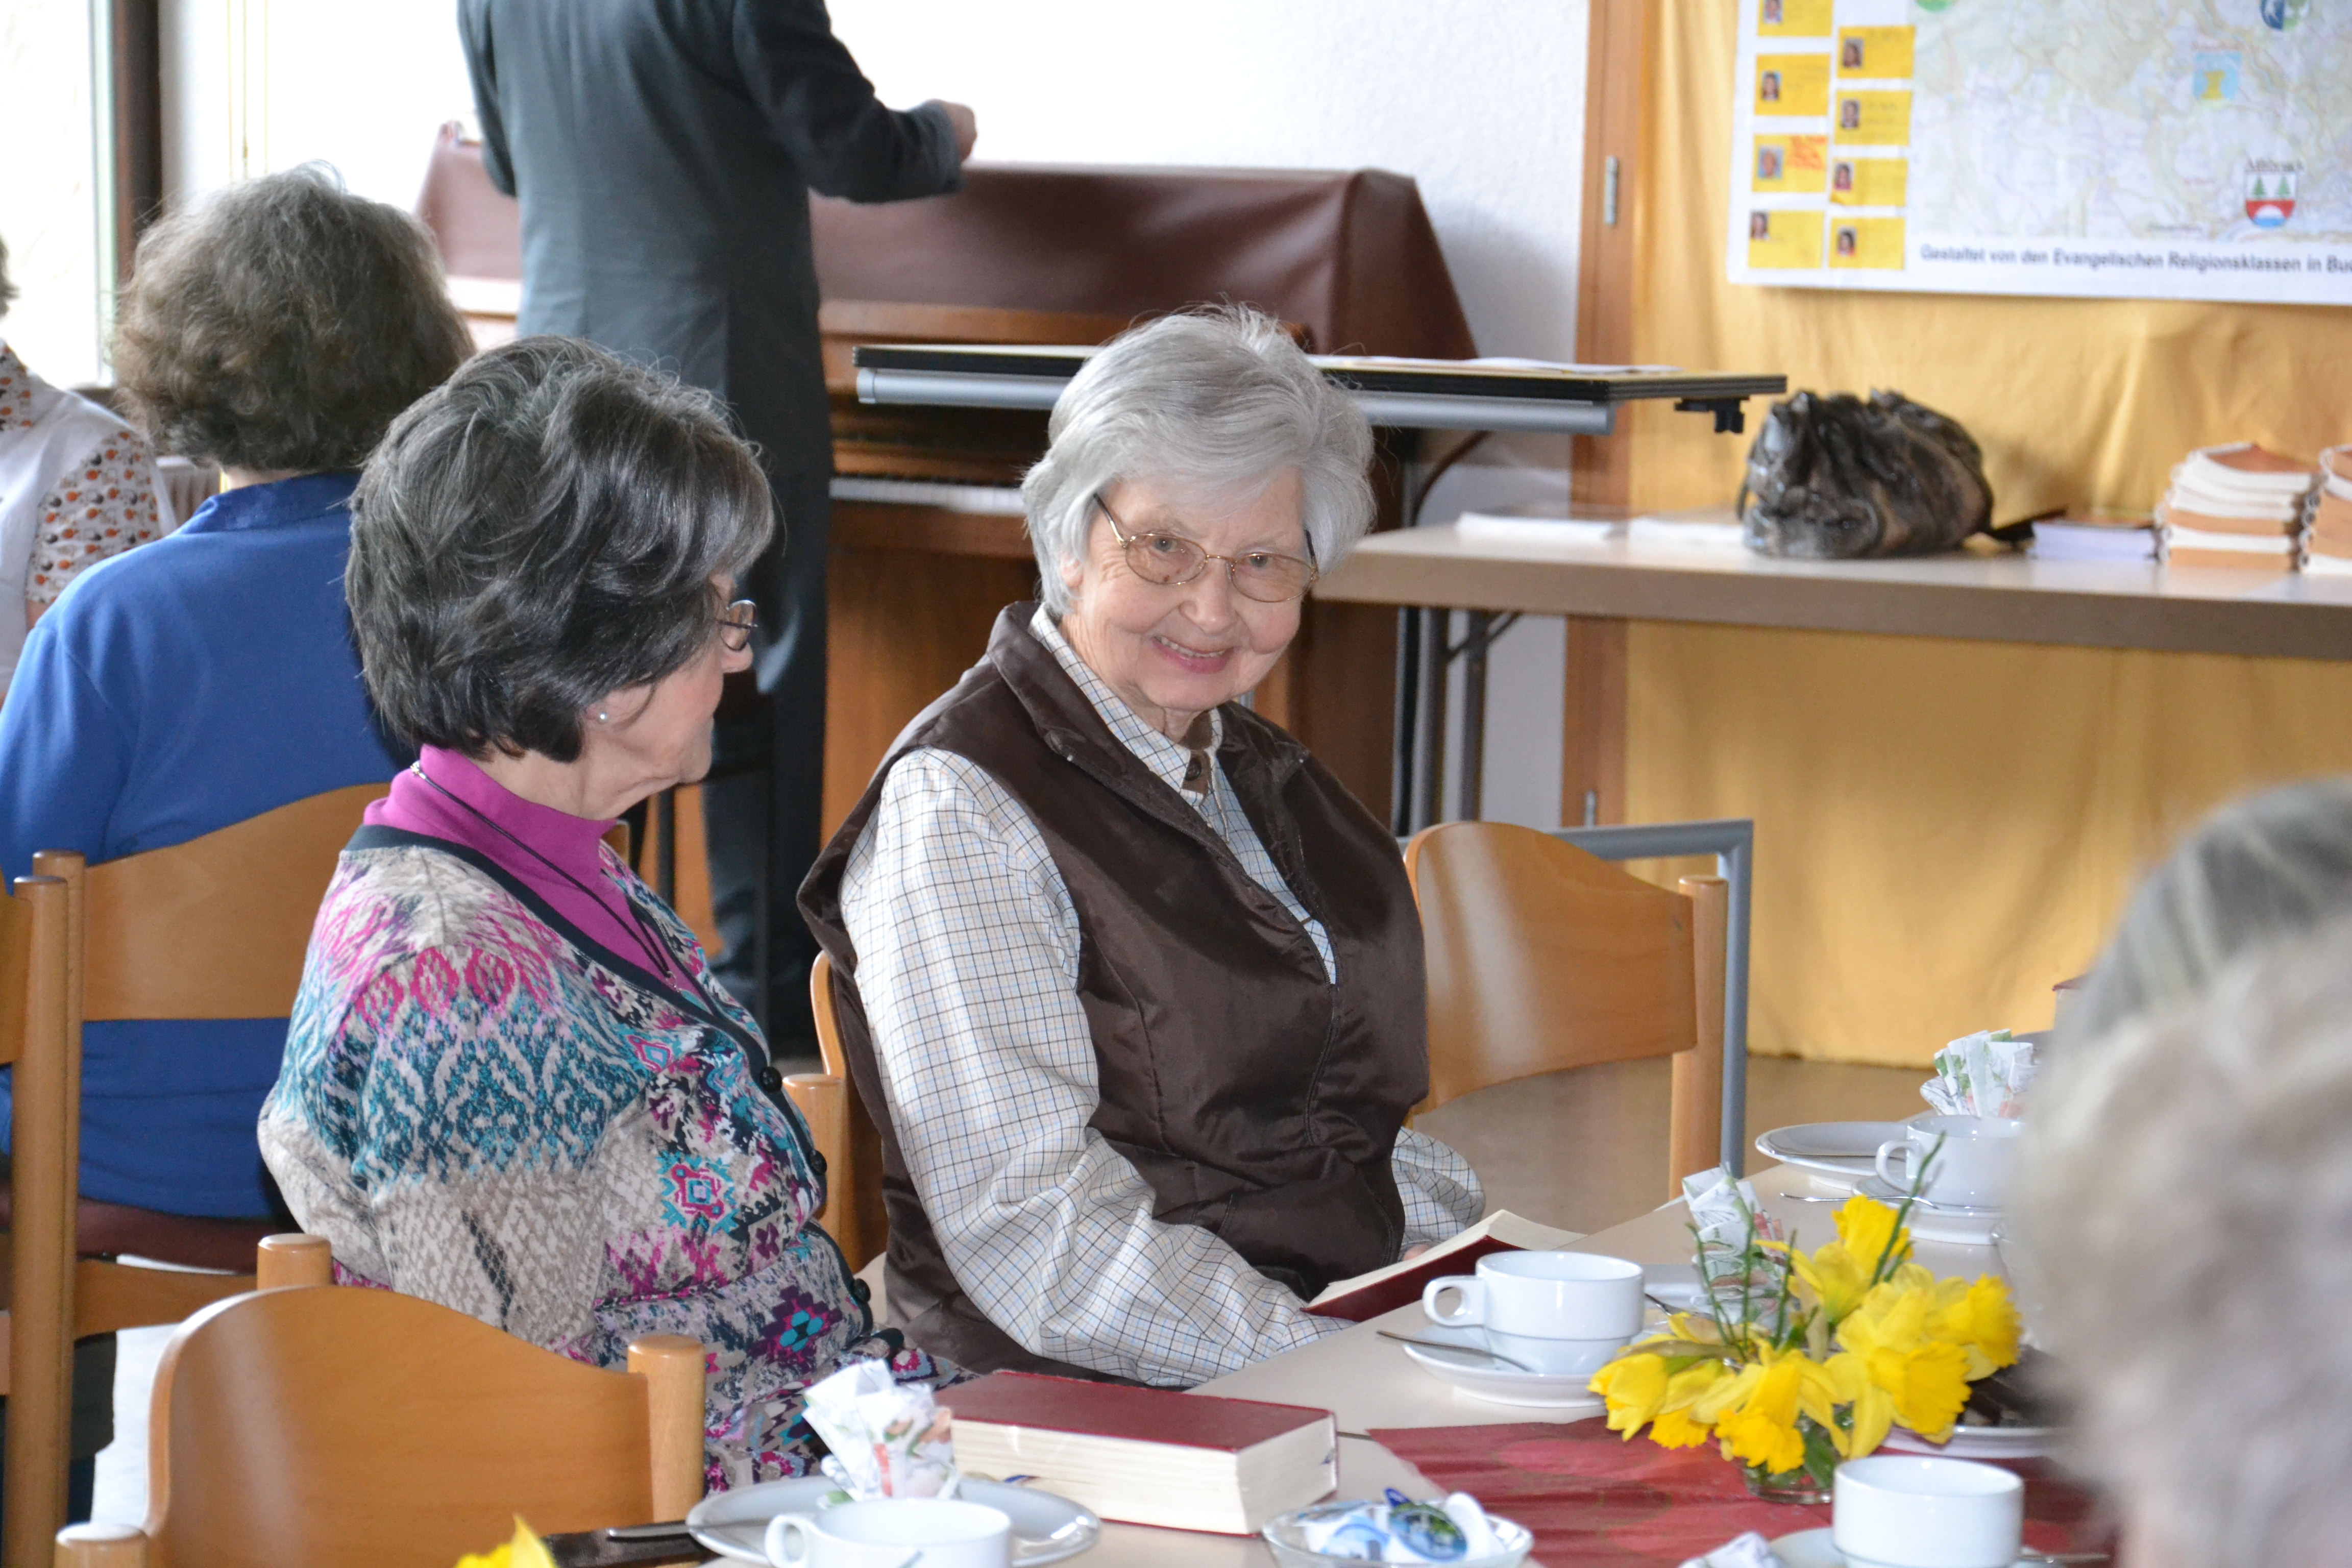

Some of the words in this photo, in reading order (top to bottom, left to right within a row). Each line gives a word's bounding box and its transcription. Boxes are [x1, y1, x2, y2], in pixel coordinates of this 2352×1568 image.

[1920, 243, 1984, 262] Gestaltet
[1990, 250, 2016, 263] von
[2021, 248, 2049, 264] den
[2054, 248, 2164, 271] Evangelischen
[2168, 251, 2301, 274] Religionsklassen
[2307, 255, 2322, 272] in
